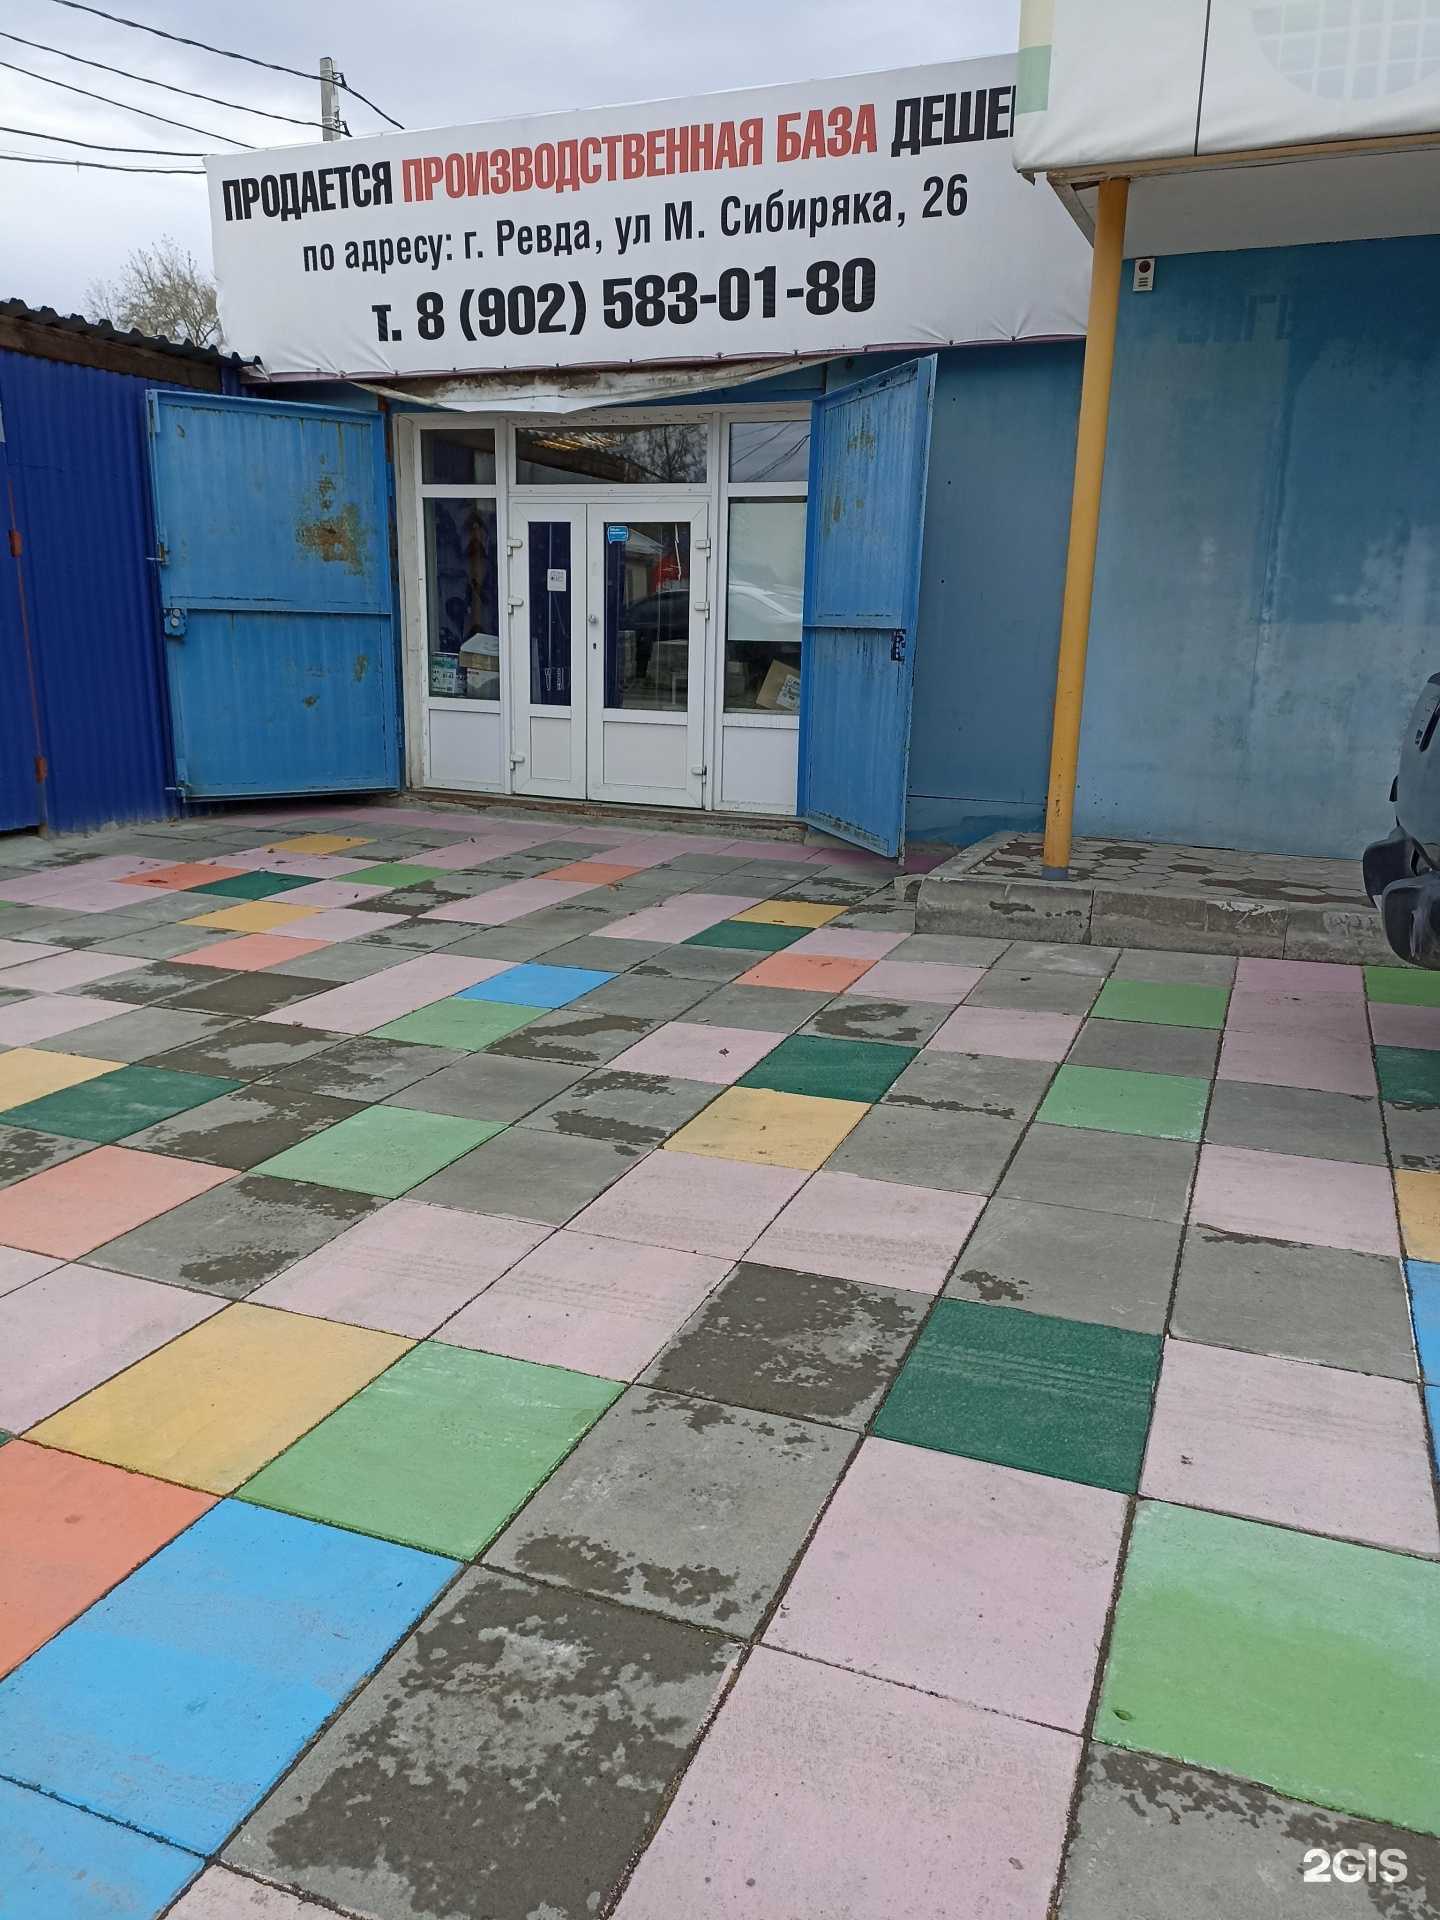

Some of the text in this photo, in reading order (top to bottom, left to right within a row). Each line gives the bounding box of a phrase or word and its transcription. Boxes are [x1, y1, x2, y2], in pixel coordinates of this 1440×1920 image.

[222, 84, 1017, 222] ПРОДАЕТСЯ ПРОИЗВОДСТВЕННАЯ БАЗА ДЕШЕ
[303, 173, 968, 275] по адресу: г. Ревда, ул М. Сибиряка, 26
[416, 291, 445, 341] 8
[459, 280, 587, 342] (902)
[602, 257, 876, 330] 583-01-80
